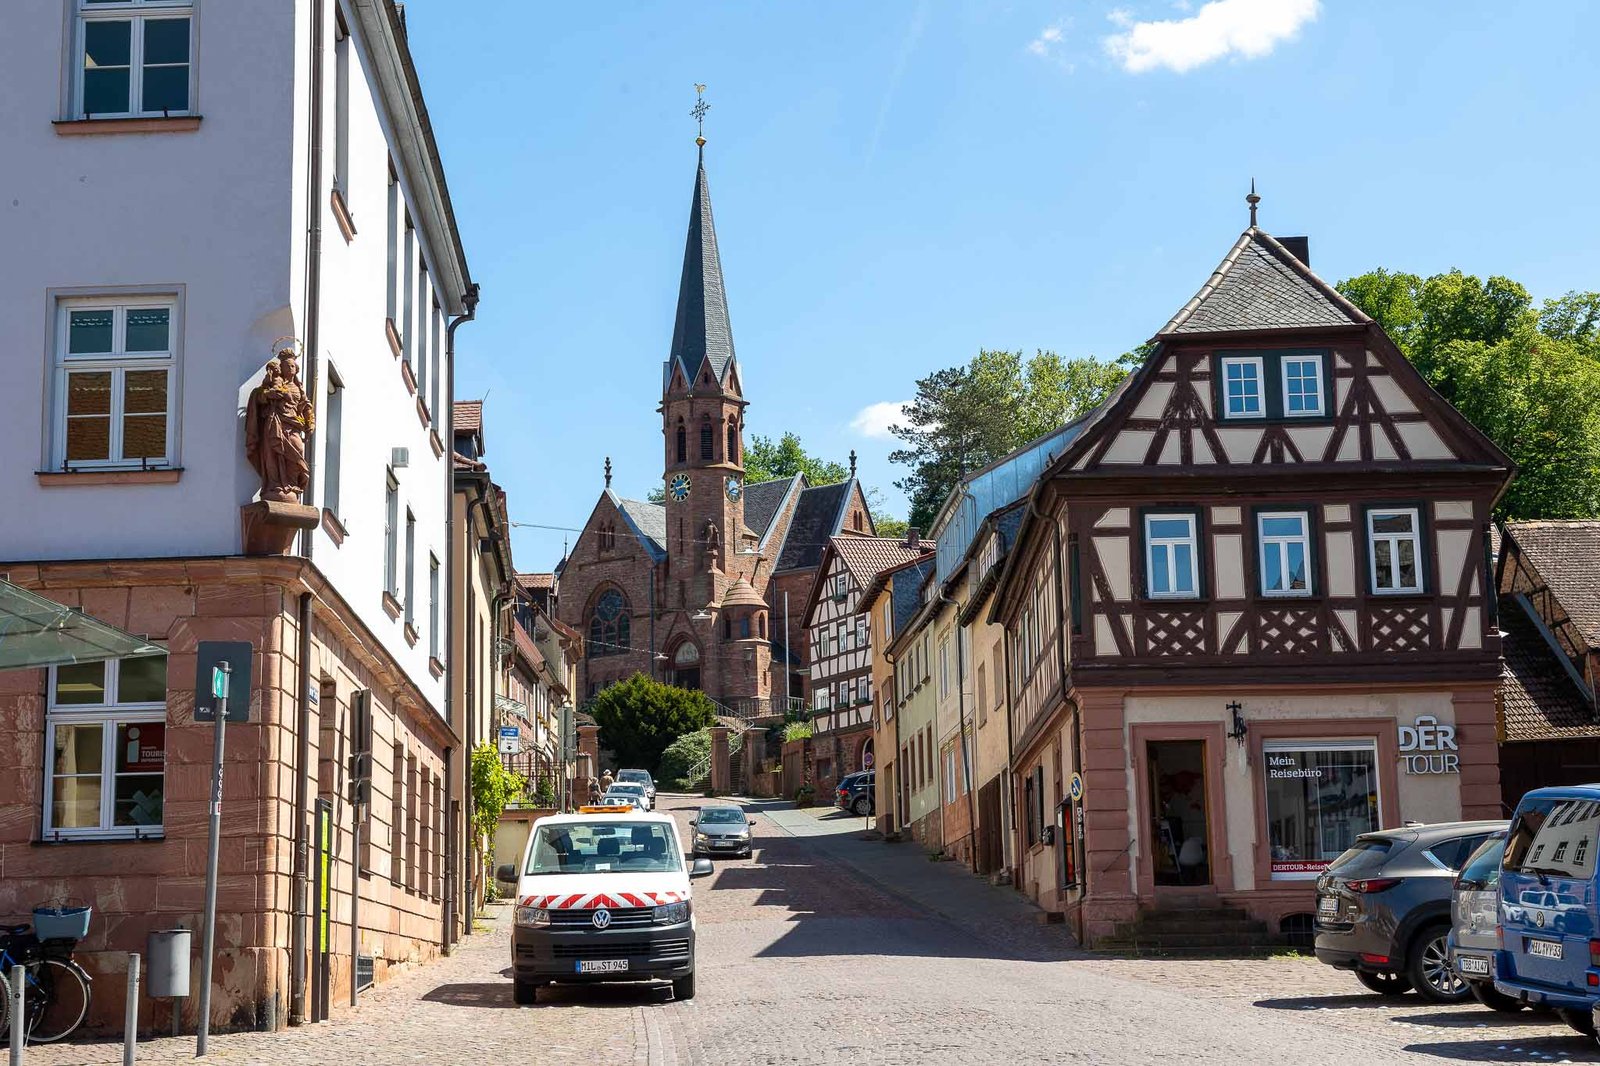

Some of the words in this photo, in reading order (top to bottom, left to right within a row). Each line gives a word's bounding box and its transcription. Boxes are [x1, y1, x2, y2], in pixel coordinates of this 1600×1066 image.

[1398, 725, 1458, 751] DER
[1269, 756, 1295, 766] Mein
[1400, 754, 1460, 774] TOUR
[1270, 768, 1322, 778] Reisebüro
[1272, 863, 1327, 871] DERTOUR-Reise
[581, 961, 596, 971] MIL
[602, 961, 611, 970] ST
[613, 960, 628, 970] 945
